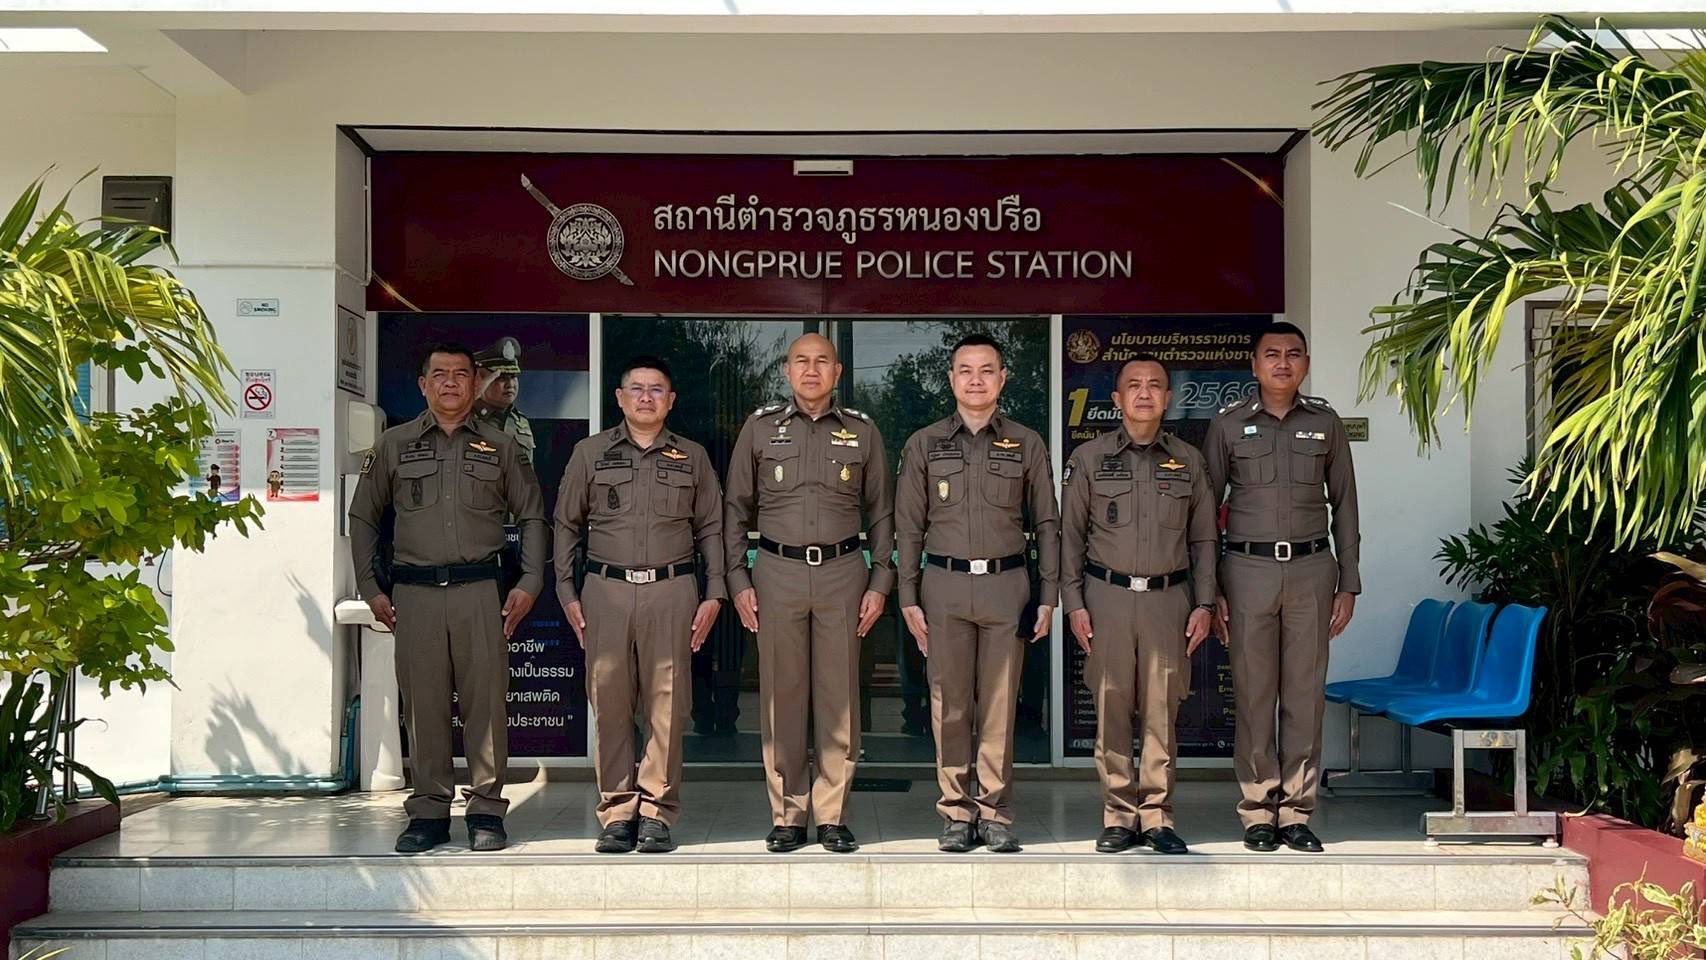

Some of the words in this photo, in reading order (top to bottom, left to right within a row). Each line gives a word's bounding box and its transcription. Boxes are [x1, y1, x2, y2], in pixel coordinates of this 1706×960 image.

[653, 194, 1041, 244] สถานีตำรวจภูธรหนองปรือ
[653, 249, 842, 279] NONGPRUE
[856, 249, 974, 279] POLICE
[986, 249, 1133, 279] STATION
[1111, 332, 1252, 345] นโยบายบริหารราชการ
[1068, 388, 1089, 427] 1
